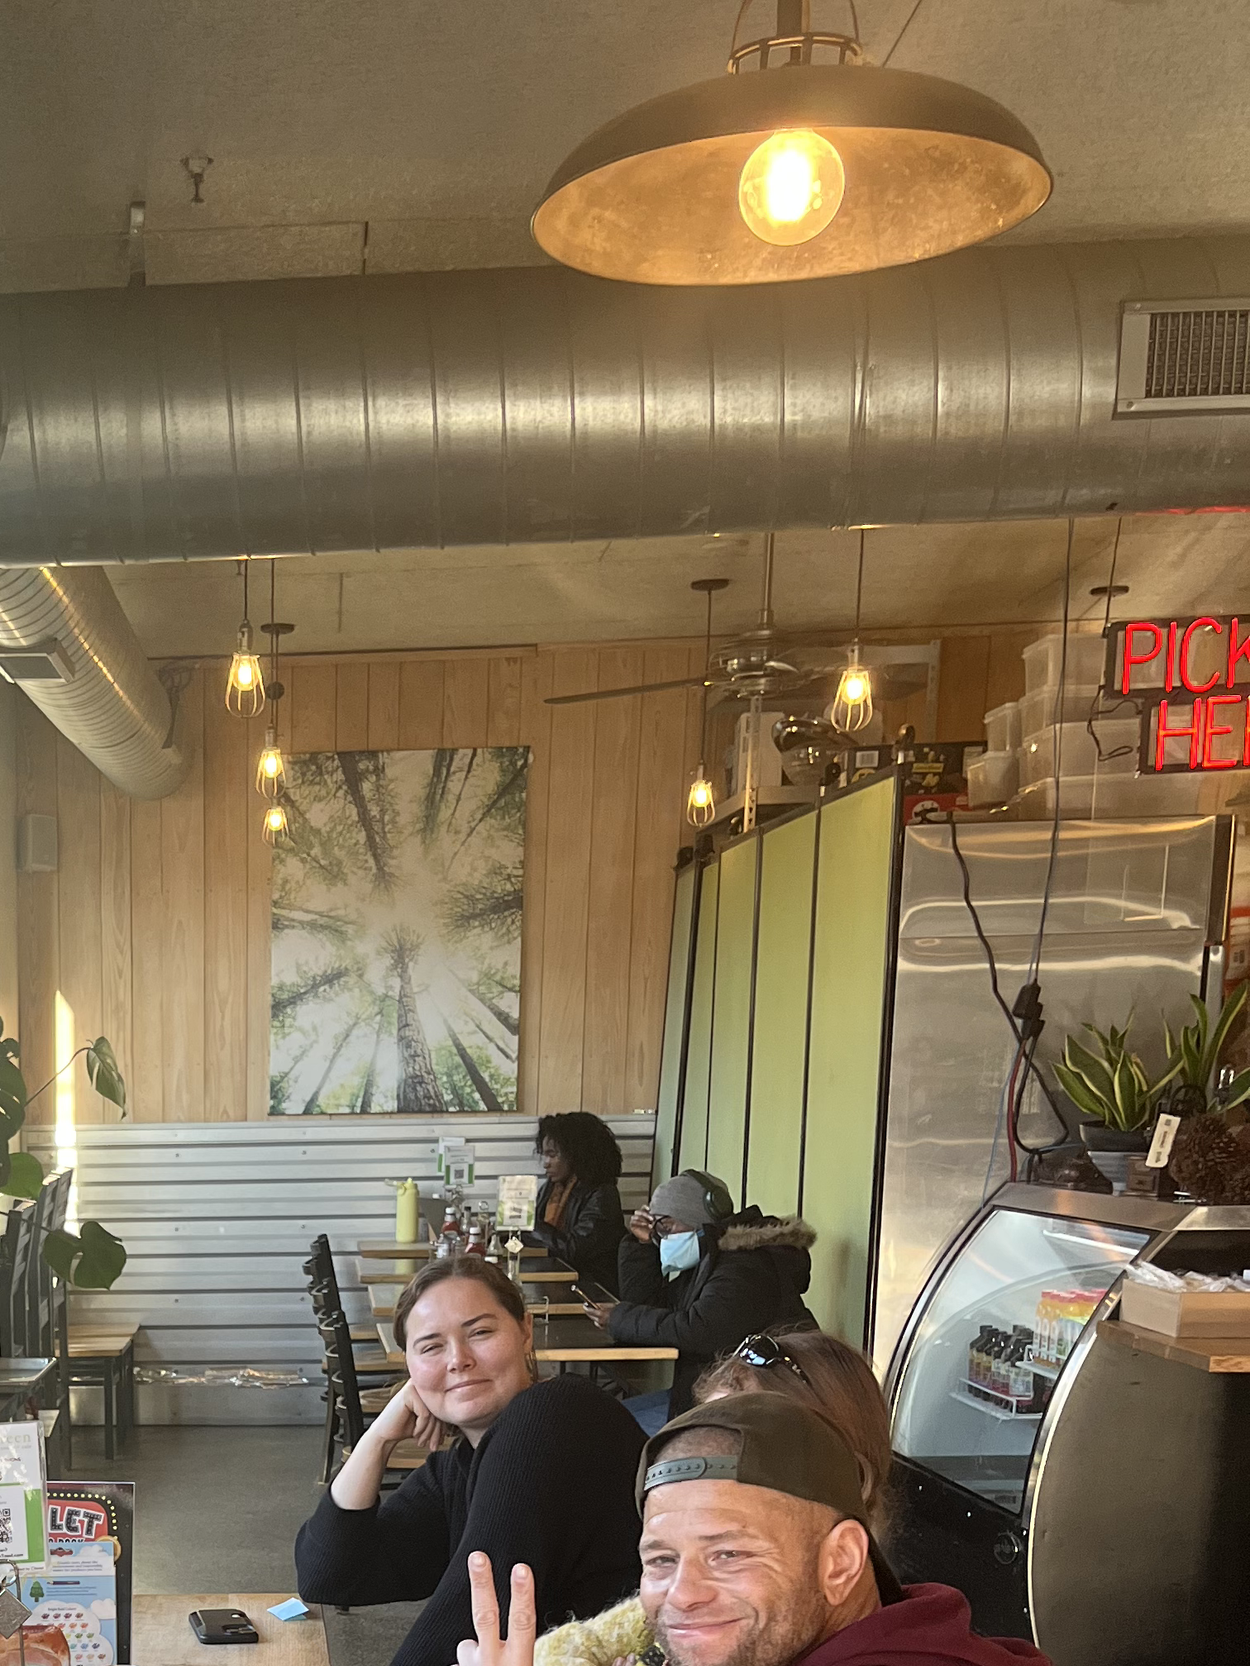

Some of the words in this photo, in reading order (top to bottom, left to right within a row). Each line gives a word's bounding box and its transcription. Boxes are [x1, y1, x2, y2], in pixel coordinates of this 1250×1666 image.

[1122, 617, 1250, 694] PICK
[1155, 694, 1250, 771] HE
[48, 1505, 104, 1538] LET
